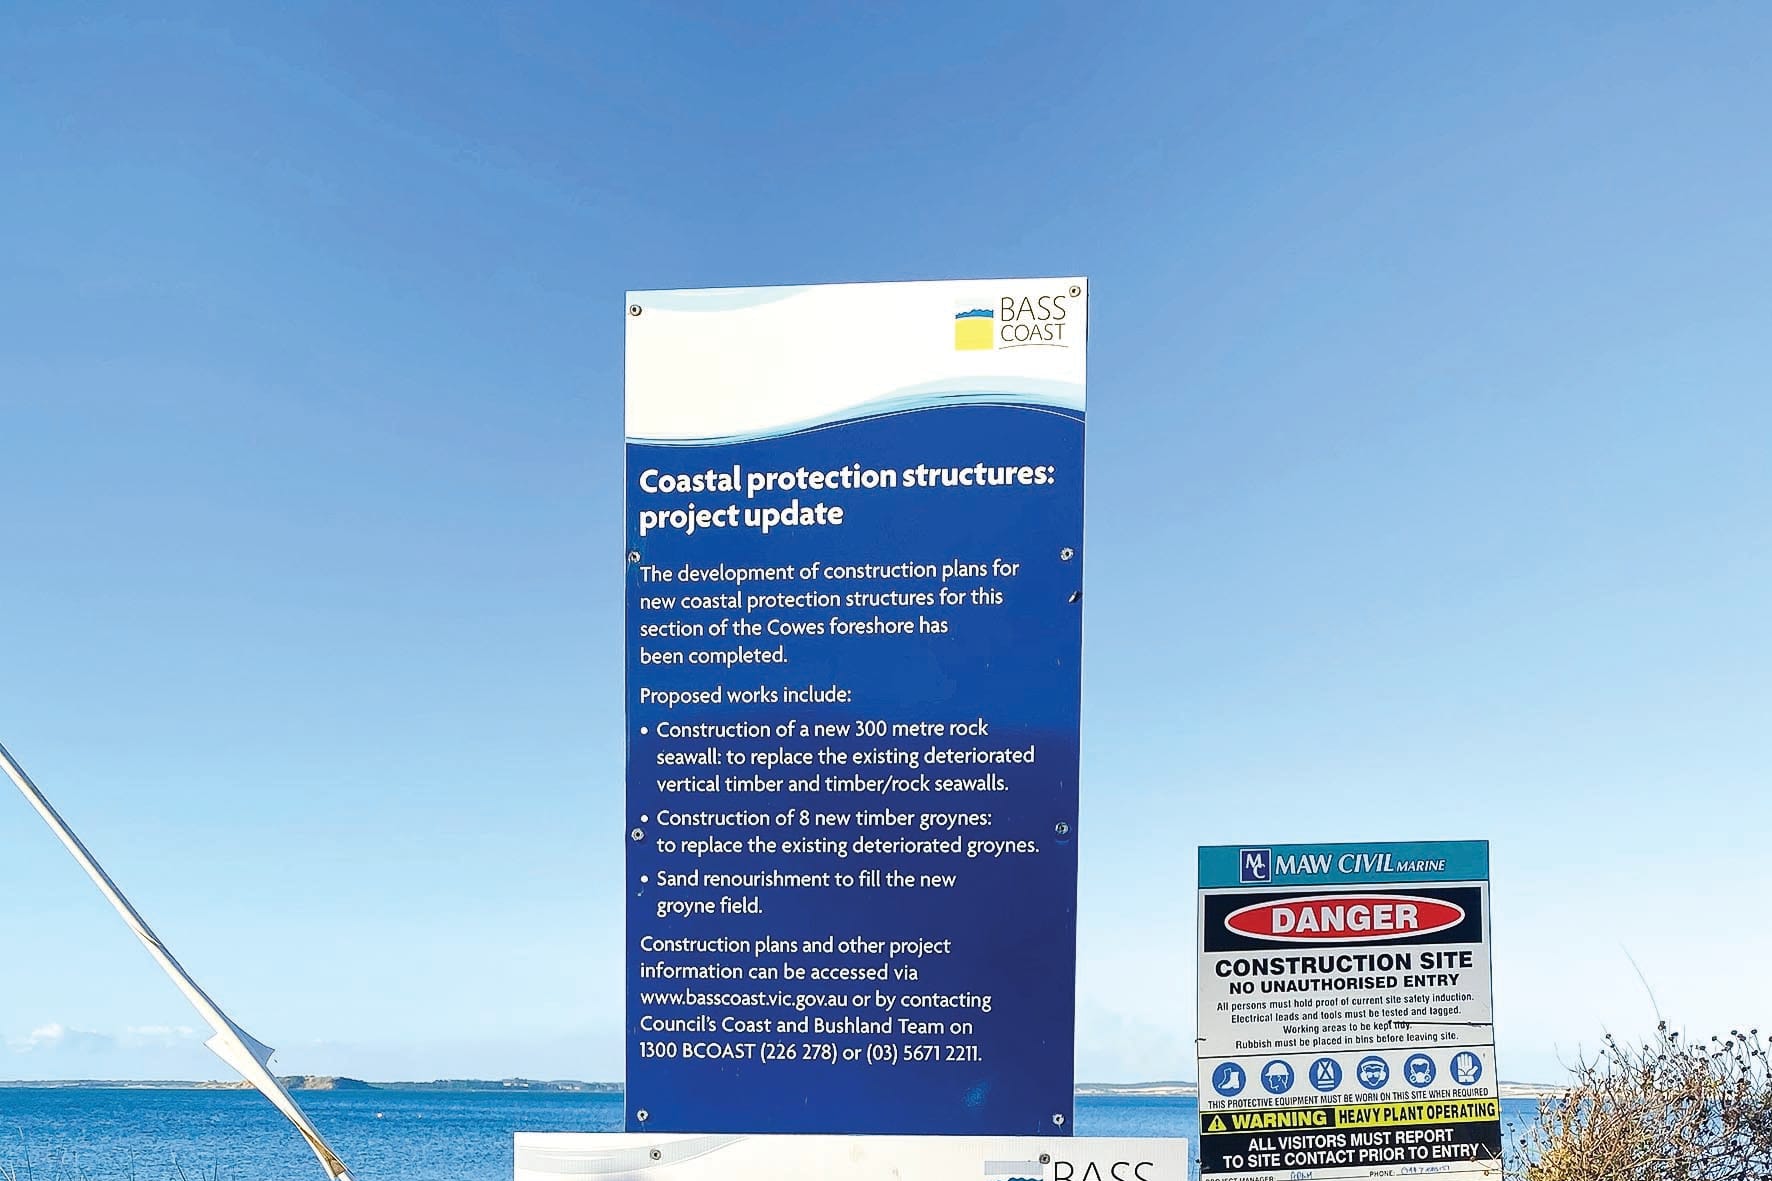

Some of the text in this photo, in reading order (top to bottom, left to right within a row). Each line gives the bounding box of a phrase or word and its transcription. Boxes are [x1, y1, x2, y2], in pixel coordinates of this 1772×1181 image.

[1001, 295, 1066, 321] BASS
[1000, 323, 1065, 342] COAST
[639, 462, 1054, 501] Coastal protection structures:
[639, 498, 843, 536] project update
[639, 558, 1019, 585] The development of construction plans for
[640, 684, 851, 708] Proposed works include:
[656, 717, 988, 737] Construction of a new 300 metre rock
[1275, 853, 1445, 874] MAW CIVIL MARINE
[1271, 904, 1419, 934] DANGER
[640, 935, 951, 958] Construction plans and other project
[1215, 950, 1473, 977] CONSTRUCTION SITE
[1229, 973, 1459, 994] NO UNAUTHORISED ENTRY
[1216, 991, 1474, 1012] All persons must hold proof of current site safety induction.
[1231, 1005, 1461, 1023] Electrical leads and tools must be tested and tagged.
[1282, 1024, 1319, 1034] Working
[1321, 1024, 1346, 1032] areas
[1349, 1022, 1357, 1031] to
[1360, 1022, 1370, 1030] be
[1235, 1031, 1458, 1049] Rubbish must be placed in bins before leaving site.
[639, 1041, 982, 1065] 1300 BCOAST (226 278) or (03) 5671 2211.
[1207, 1087, 1488, 1109] THIS PROTECTIVE EQUIPMENT MUST BE WORN ON THIS SITE WHEN REQUIRED
[1230, 1108, 1327, 1129] WARNING
[1338, 1102, 1495, 1124] HEAVY PLANT OPERATING
[1248, 1128, 1454, 1151] ALL VISITORS MUST REPORT
[1222, 1143, 1479, 1168] TO SITE CONTACT PRIOR TO ENTRY
